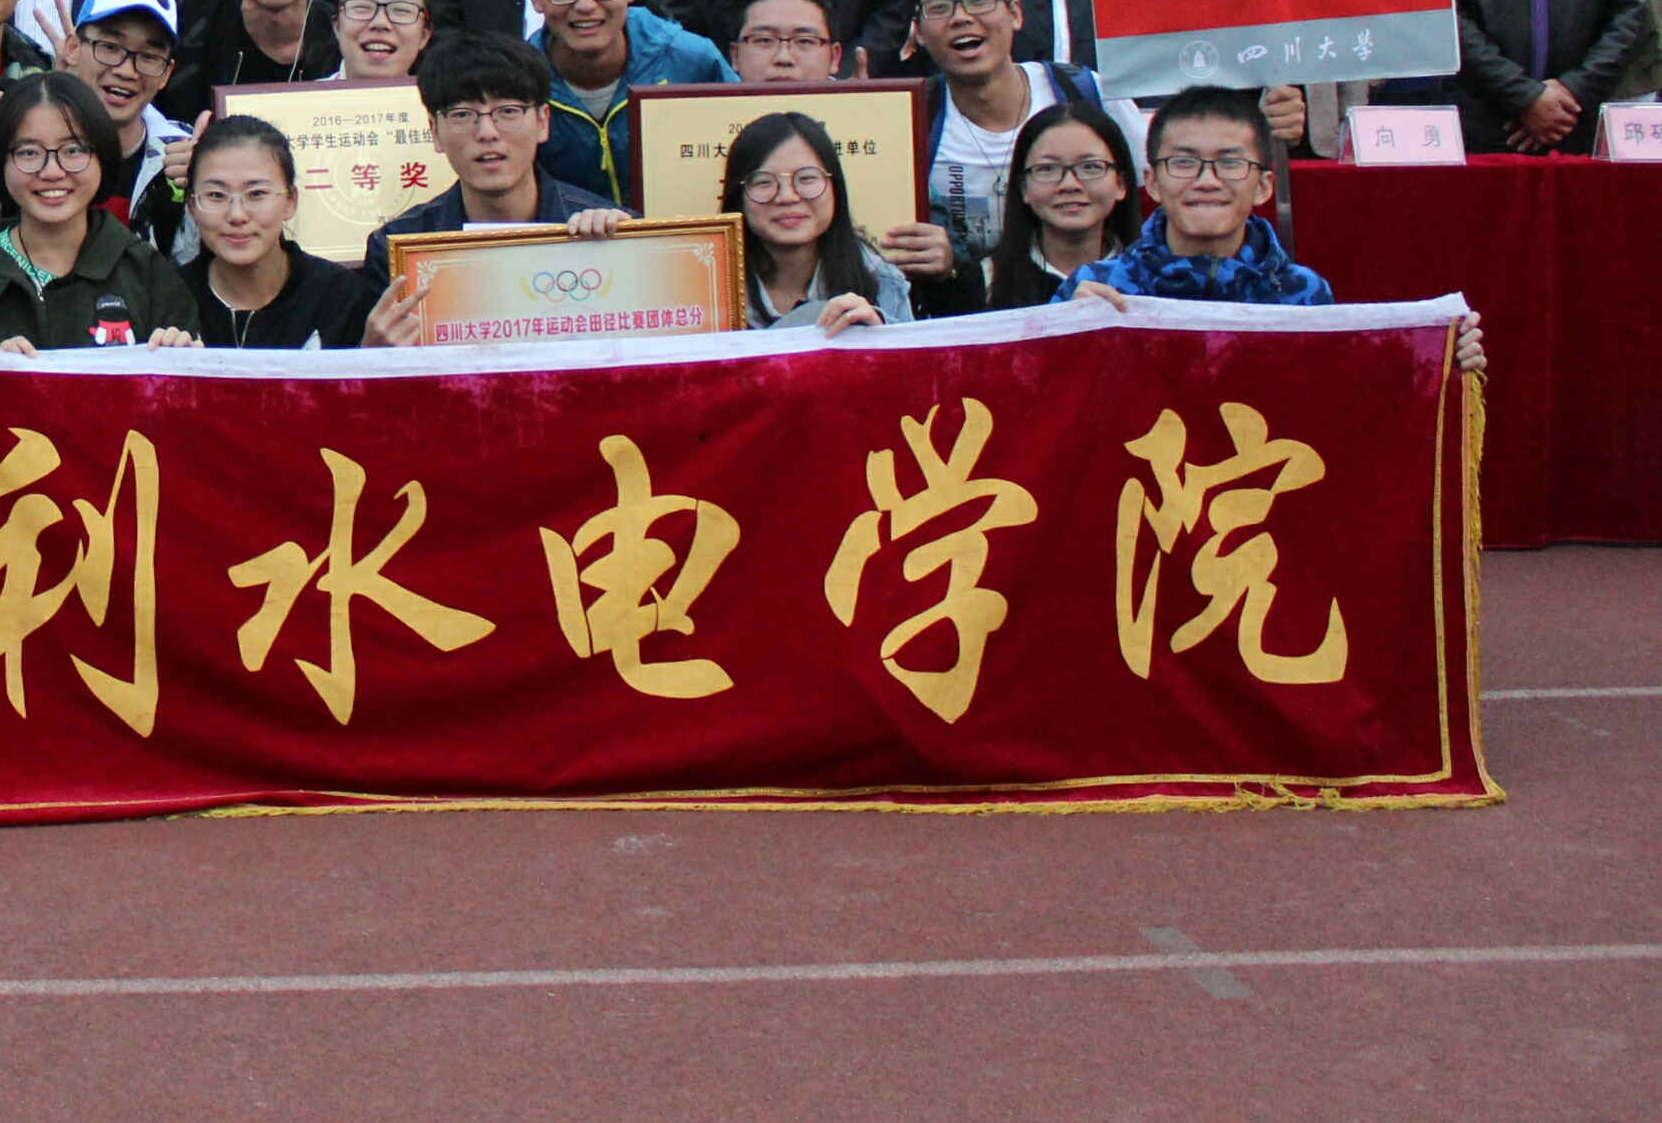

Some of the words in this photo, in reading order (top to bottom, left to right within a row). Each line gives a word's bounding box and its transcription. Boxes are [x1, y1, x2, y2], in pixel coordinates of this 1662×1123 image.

[304, 161, 429, 191] 二等奖
[434, 306, 704, 342] 四川大学2017年运动会田径比赛团体总分
